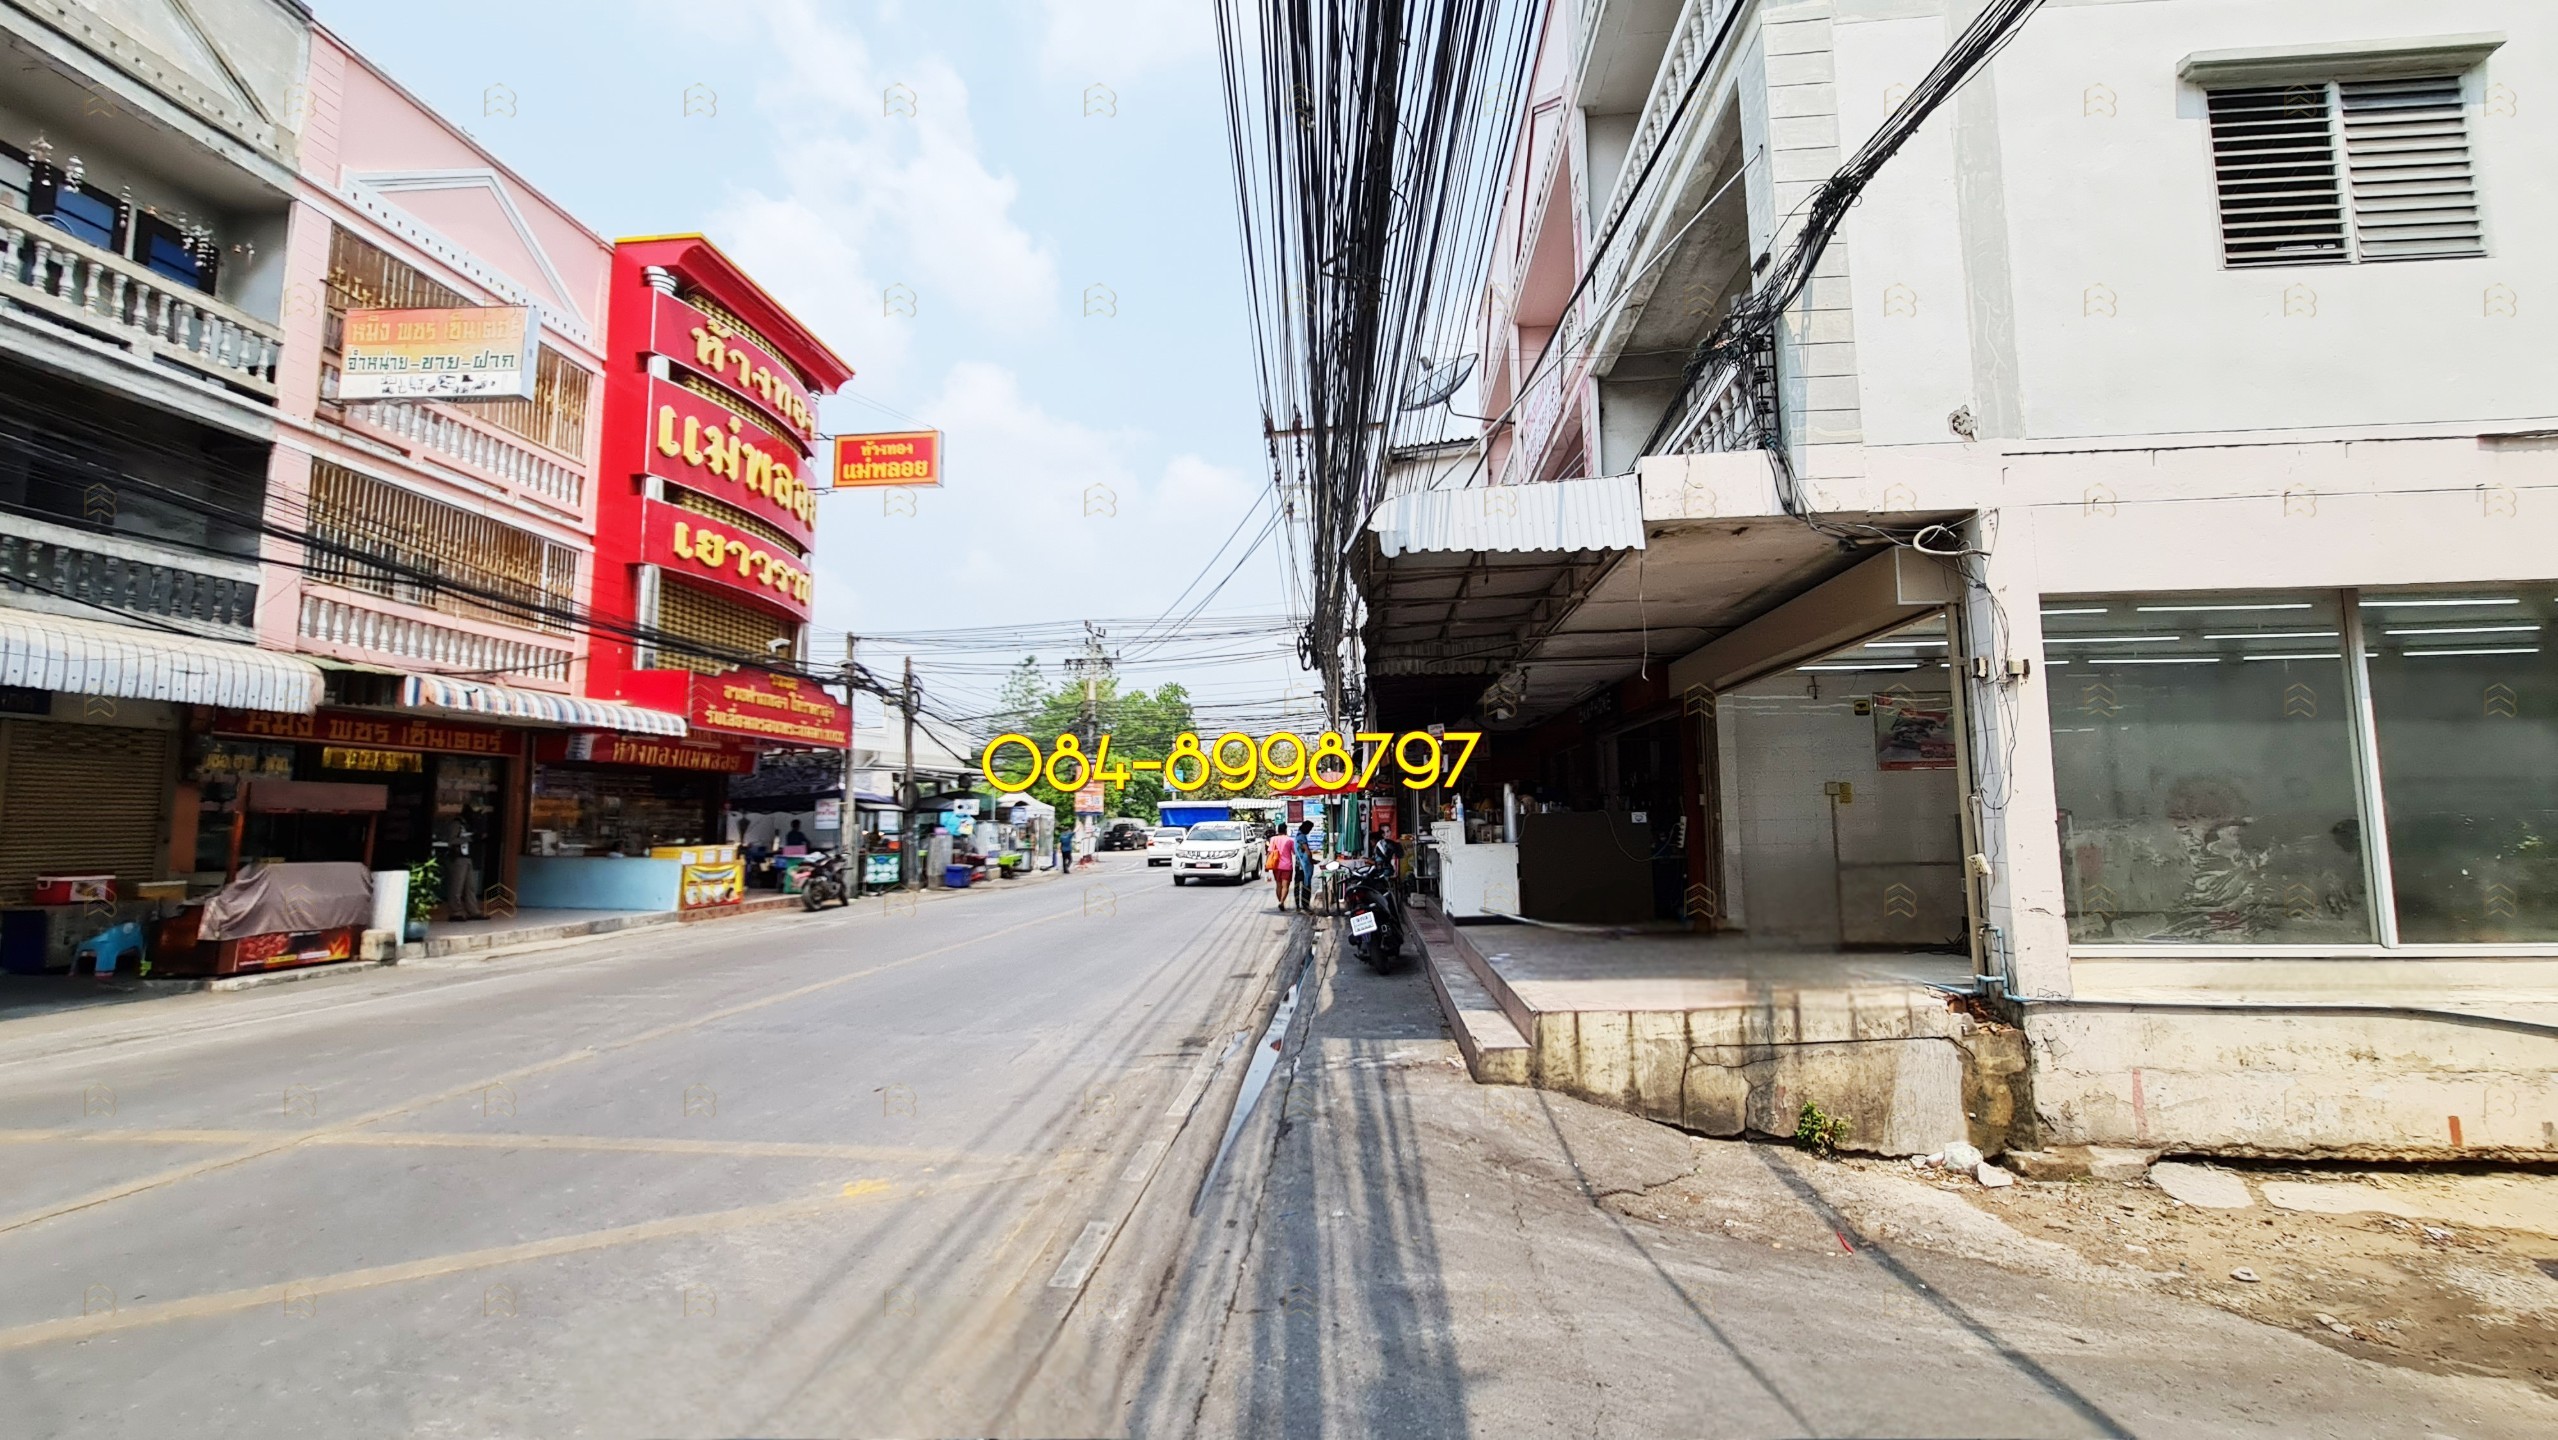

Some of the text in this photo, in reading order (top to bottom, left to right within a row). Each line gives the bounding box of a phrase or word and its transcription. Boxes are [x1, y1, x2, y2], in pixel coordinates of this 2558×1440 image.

[860, 440, 914, 457] ห้างทอง
[842, 457, 929, 480] แม่พลอย
[329, 718, 391, 743] พชร
